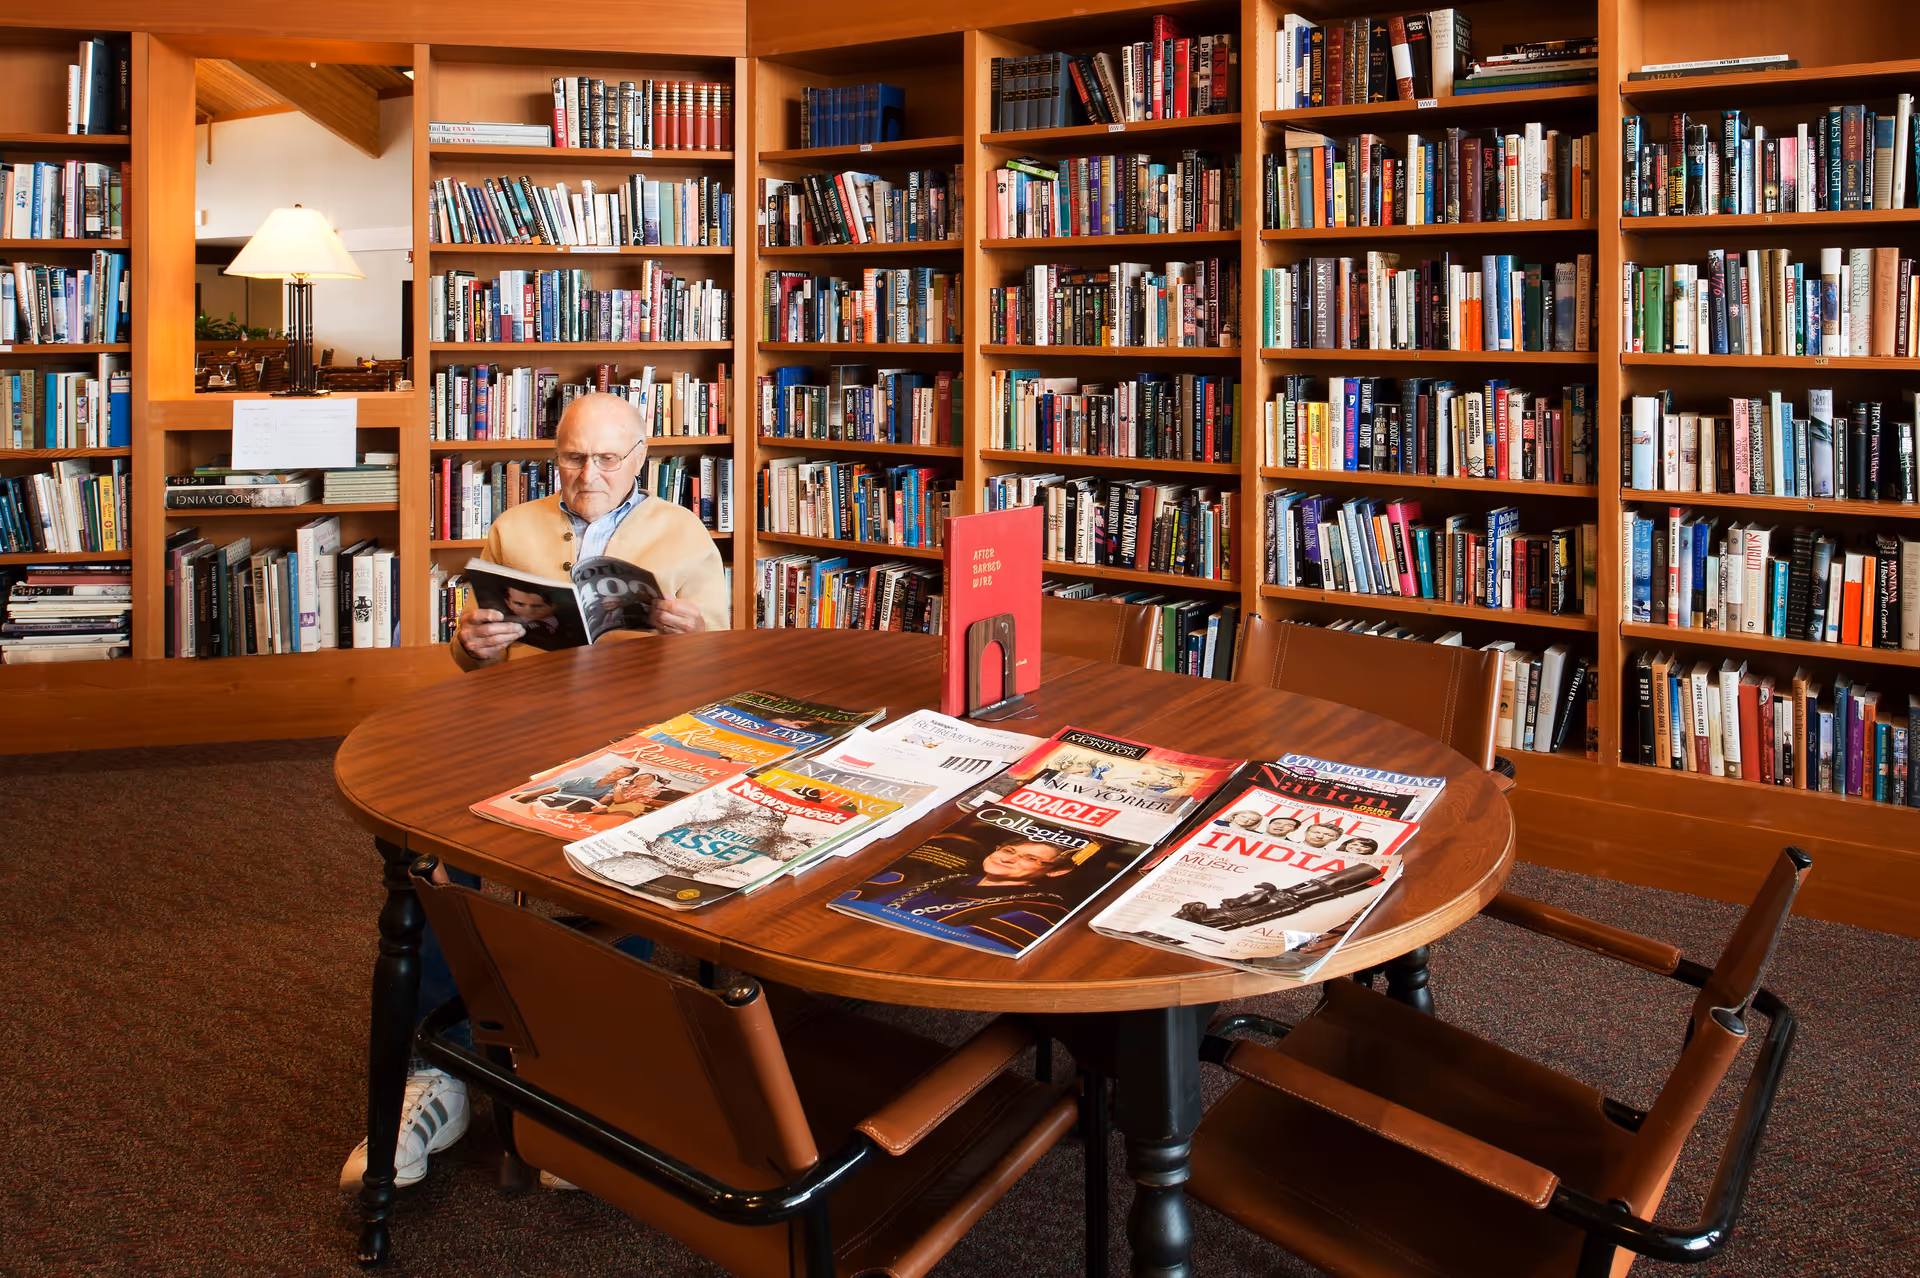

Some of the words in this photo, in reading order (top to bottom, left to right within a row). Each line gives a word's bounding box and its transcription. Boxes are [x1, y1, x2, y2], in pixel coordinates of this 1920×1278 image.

[1627, 124, 1635, 143] ROBERT
[1725, 119, 1734, 138] ROBERT
[1831, 116, 1841, 143] WEST
[1627, 144, 1636, 162] LUDLUM
[1725, 140, 1734, 158] LUDLUM
[1848, 135, 1856, 149] Silk
[1185, 175, 1193, 192] Beirut
[1831, 159, 1841, 193] NIGHT
[1848, 164, 1856, 189] Cyanide
[1184, 201, 1193, 226] Jerusalem
[864, 273, 874, 311] AIRFRAME
[1317, 263, 1327, 298] NORTH
[1712, 273, 1724, 296] 1776
[1861, 263, 1870, 297] COLLEEN
[1317, 302, 1327, 337] SOUTH
[1286, 401, 1295, 422] OVER
[1871, 406, 1880, 432] LEGACY
[1286, 423, 1295, 438] THE
[1389, 422, 1398, 446] KOONTZ
[1287, 439, 1295, 459] EDGE
[176, 495, 207, 505] VINCI
[1110, 487, 1120, 502] DAVID
[1127, 500, 1135, 513] THE
[1108, 502, 1119, 534] HALBERSTAM
[1122, 514, 1137, 556] RECKONING
[1277, 528, 1285, 558] AMERICA
[973, 548, 995, 561] AFTER
[1349, 534, 1361, 564] AMERICA
[1641, 548, 1649, 559] THE
[765, 568, 773, 590] Legacy
[972, 560, 1002, 575] BARBED
[1641, 560, 1649, 580] WORLD
[972, 578, 993, 588] WIRE
[1888, 560, 1897, 603] MONTANA
[1656, 672, 1664, 682] THE
[1656, 682, 1665, 715] HODGEPODGE
[1725, 683, 1733, 713] AUDACITY
[702, 707, 765, 730] HOMES
[768, 727, 816, 745] LAND
[913, 719, 984, 746] RETIREMENT
[984, 738, 1024, 752] REPORT
[930, 719, 959, 731] Kiplinger's
[1726, 721, 1734, 738] HOPE
[680, 724, 775, 758] Reminisce
[1066, 734, 1138, 758] MONITOR
[610, 741, 729, 778] Reminisce
[1283, 754, 1369, 778] COUNTRY
[1370, 770, 1439, 788] LIVING
[796, 763, 925, 800] NATURE
[1046, 778, 1089, 796] NEW
[1371, 781, 1425, 795] STYLE
[735, 782, 848, 825] Newsweek
[768, 773, 886, 815] TEACHING
[1253, 789, 1288, 807] Special
[1290, 799, 1326, 812] Election
[1326, 808, 1364, 820] Preview
[1010, 791, 1104, 823] ORACLE
[1353, 804, 1393, 815] LOSING
[975, 808, 1090, 849] Collegian
[1264, 800, 1382, 840] TIME
[656, 827, 773, 865] ASSET
[707, 827, 760, 845] LIQUID
[1179, 854, 1249, 874] MUSIC
[1188, 850, 1230, 863] SPECIAL
[881, 906, 911, 920] MONTANA
[911, 916, 931, 928] STATE
[931, 924, 971, 940] UNIVERSITY
